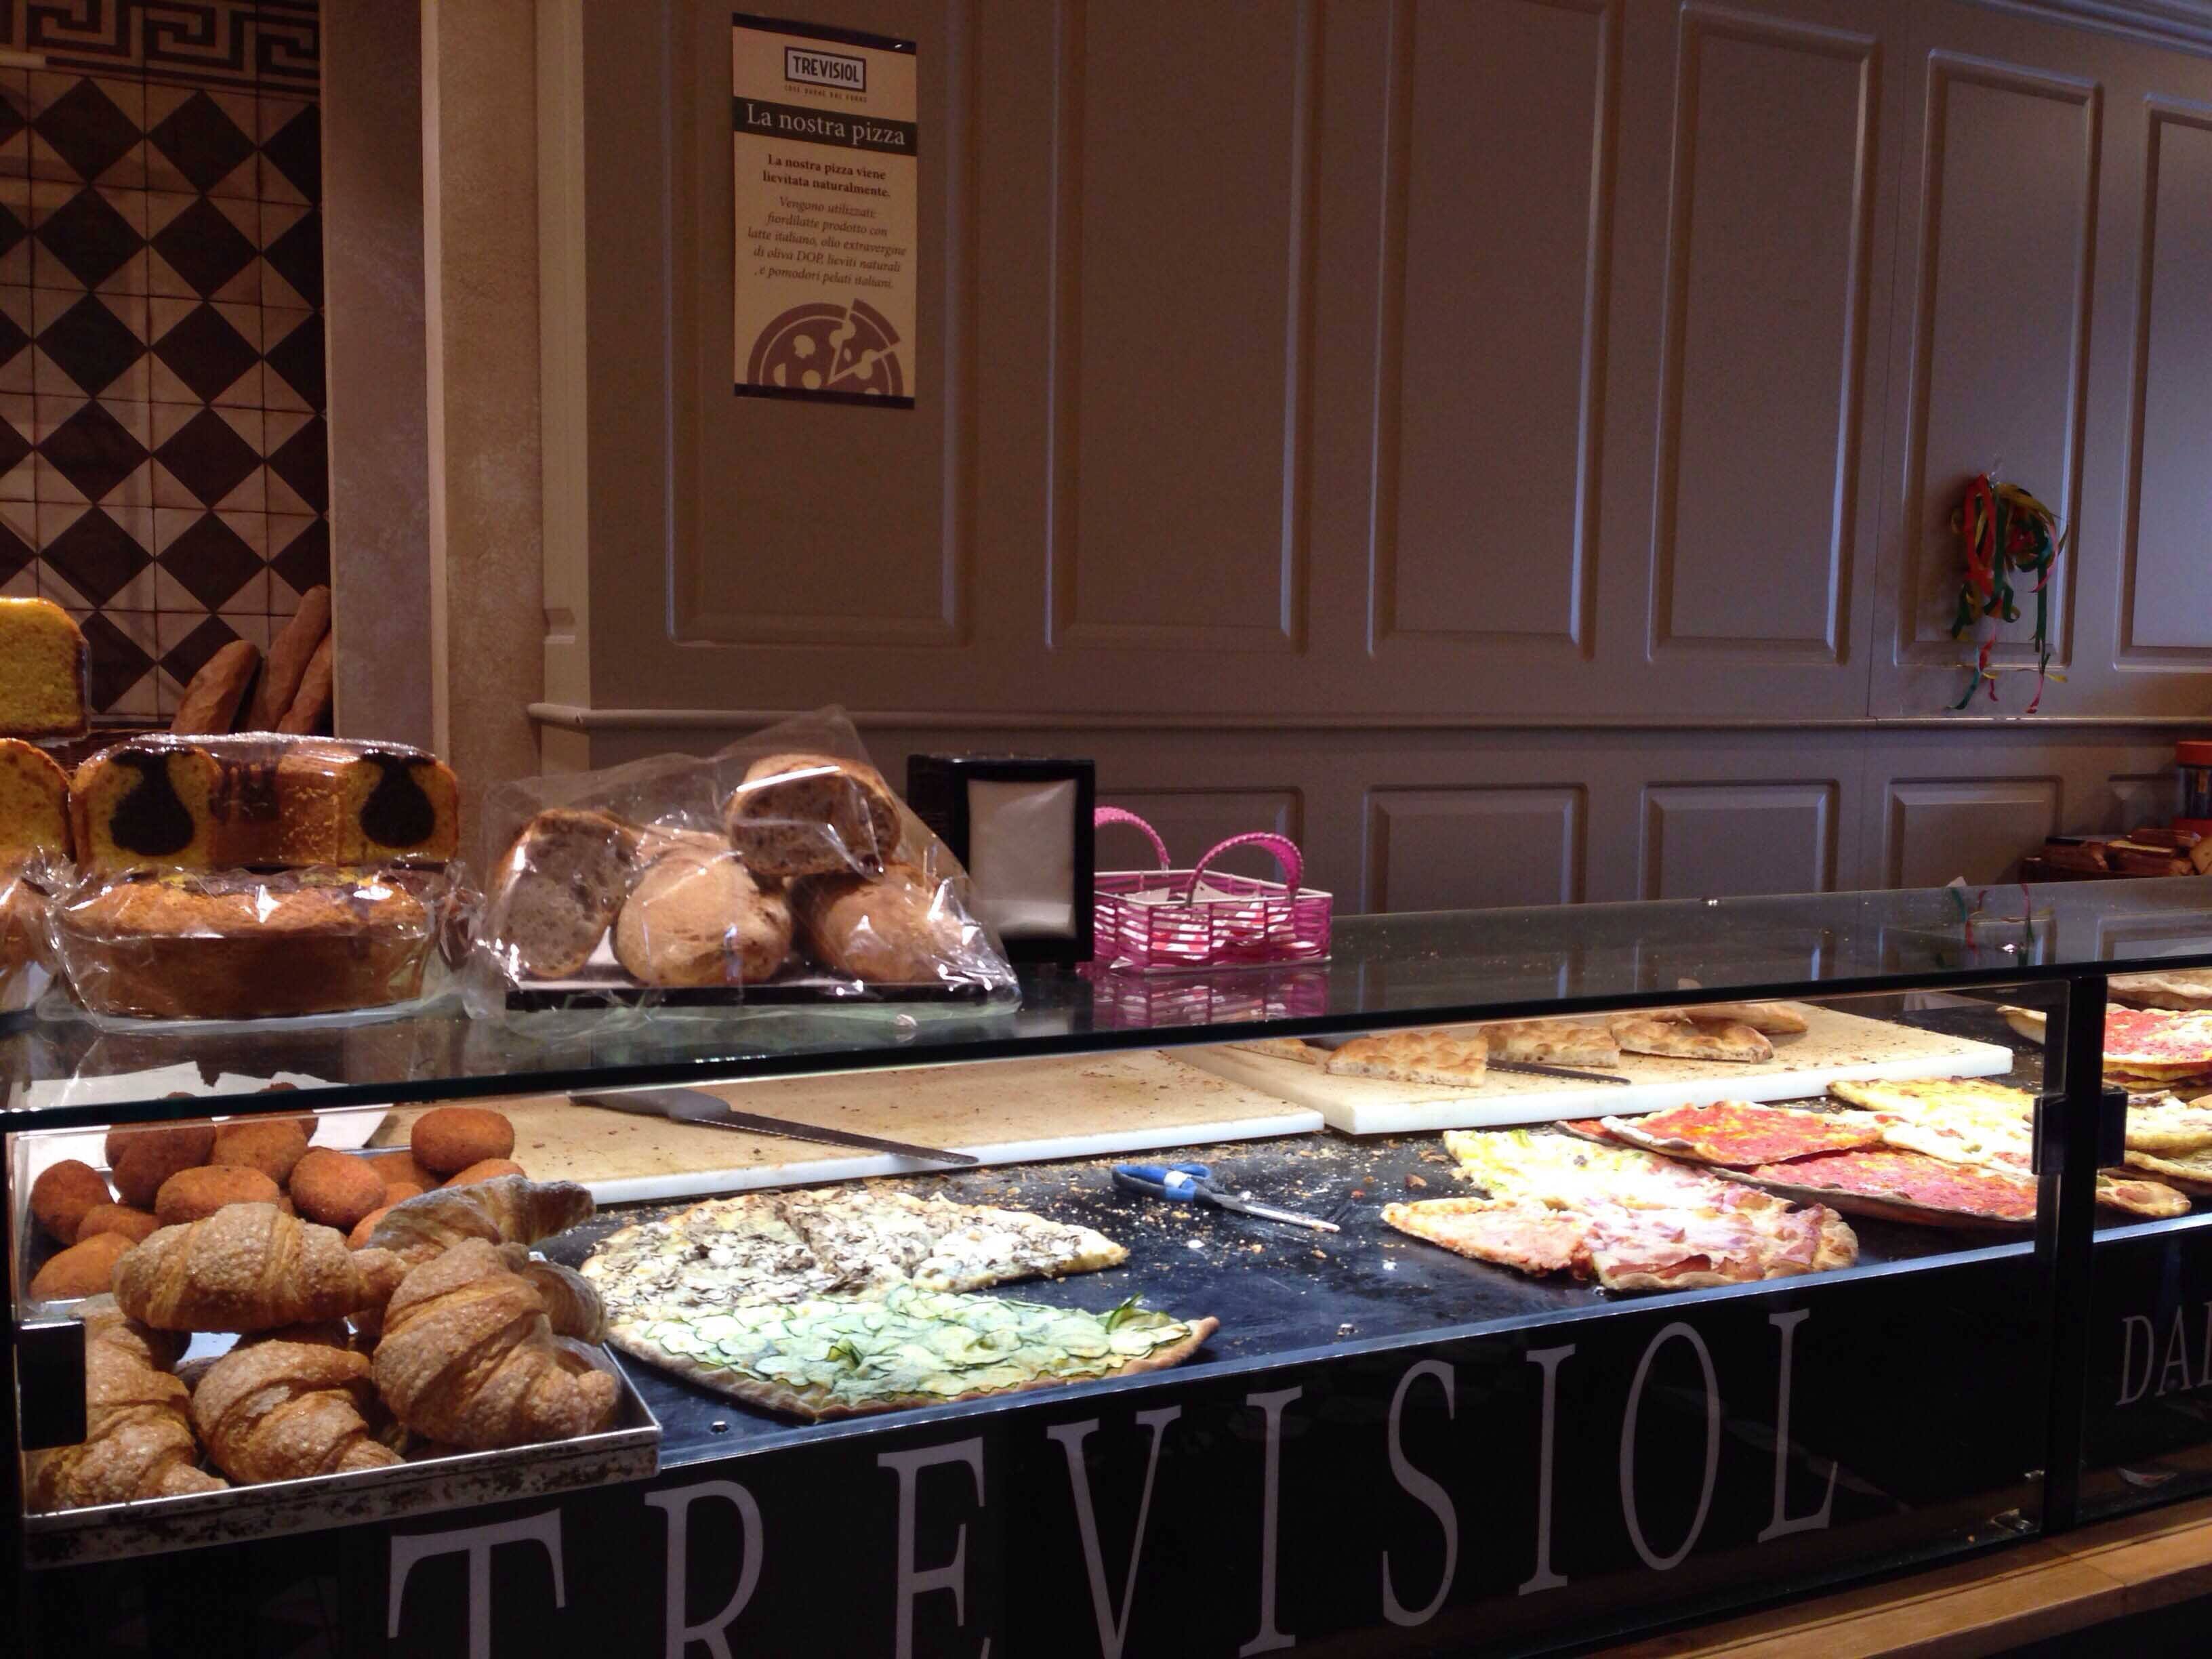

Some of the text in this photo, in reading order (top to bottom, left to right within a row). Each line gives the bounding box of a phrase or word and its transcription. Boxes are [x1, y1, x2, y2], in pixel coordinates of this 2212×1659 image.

[792, 55, 860, 83] TREVISIOL
[747, 103, 905, 145] La nostra pizza
[767, 153, 886, 180] La nostra pizza viene
[762, 169, 890, 197] lievitata naturalmente.
[779, 196, 825, 213] Vengono
[821, 220, 867, 236] prodotto
[869, 228, 888, 237] con
[747, 227, 772, 241] latte
[821, 236, 840, 249] olio
[843, 240, 907, 258] extravergine
[753, 245, 765, 258] di
[767, 247, 794, 260] oliva
[827, 253, 857, 268] lieviti
[859, 259, 901, 272] naturali
[767, 267, 820, 281] pomodori
[822, 272, 853, 285] pelati
[387, 1308, 1838, 1659] TREVISIOL
